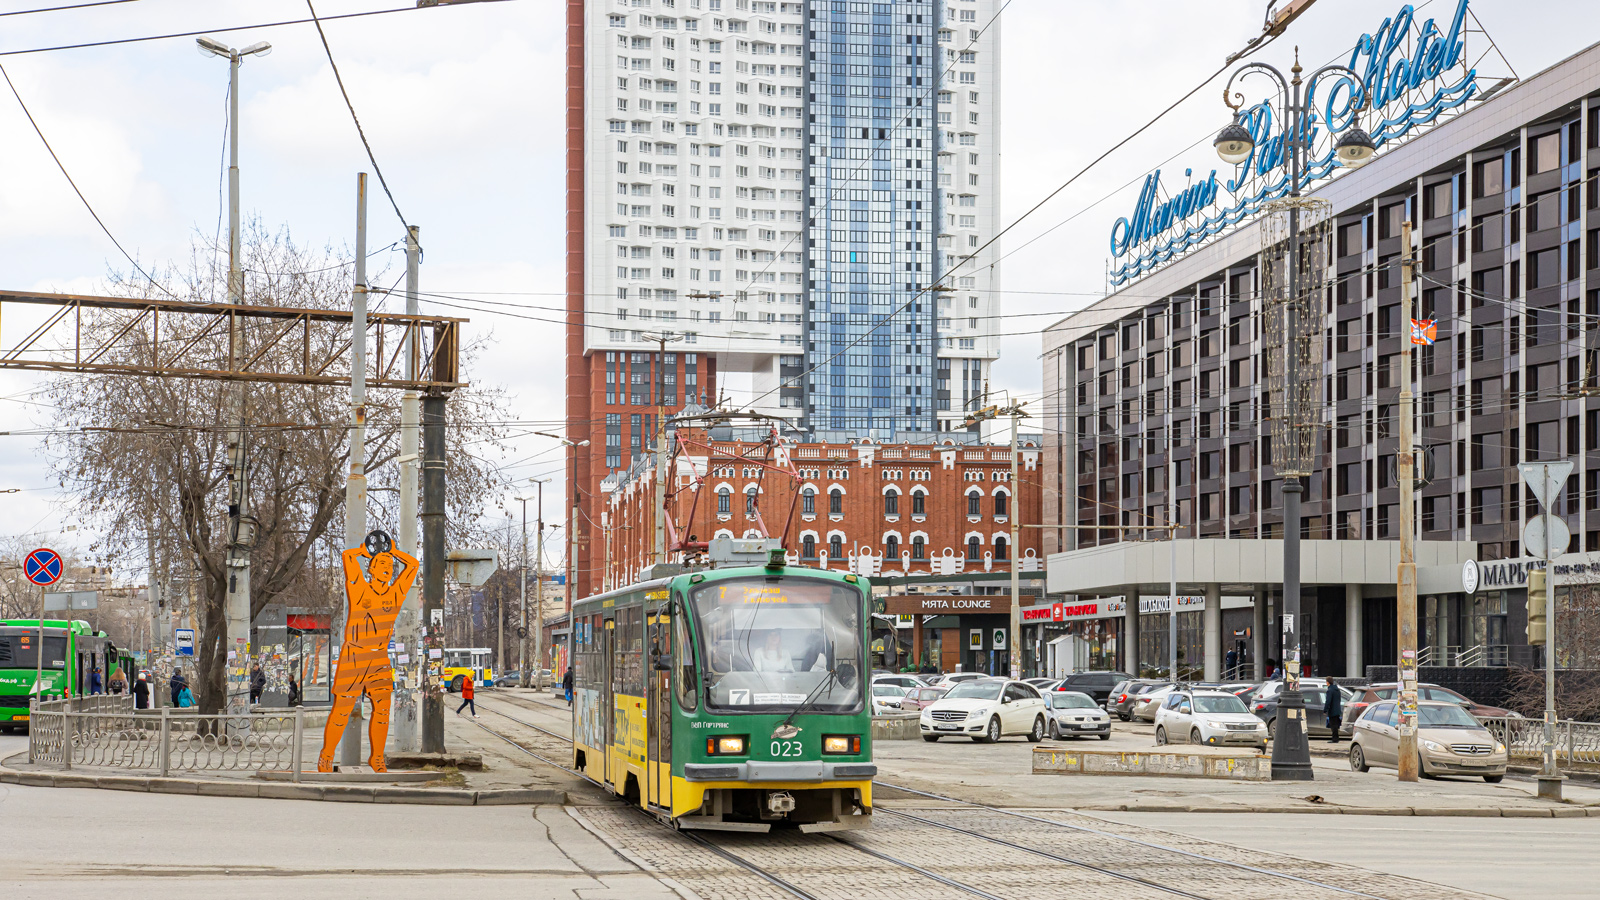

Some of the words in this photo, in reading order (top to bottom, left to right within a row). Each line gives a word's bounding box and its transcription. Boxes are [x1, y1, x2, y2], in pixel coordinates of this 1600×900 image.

[1110, 168, 1218, 258] Marins
[1325, 0, 1469, 133] Hotel
[719, 586, 727, 599] 7
[921, 599, 949, 609] МЯТА
[952, 599, 991, 609] LOUNGE
[1064, 604, 1097, 616] ТАНУКИ
[731, 690, 748, 705] 7
[770, 741, 803, 757] 023
